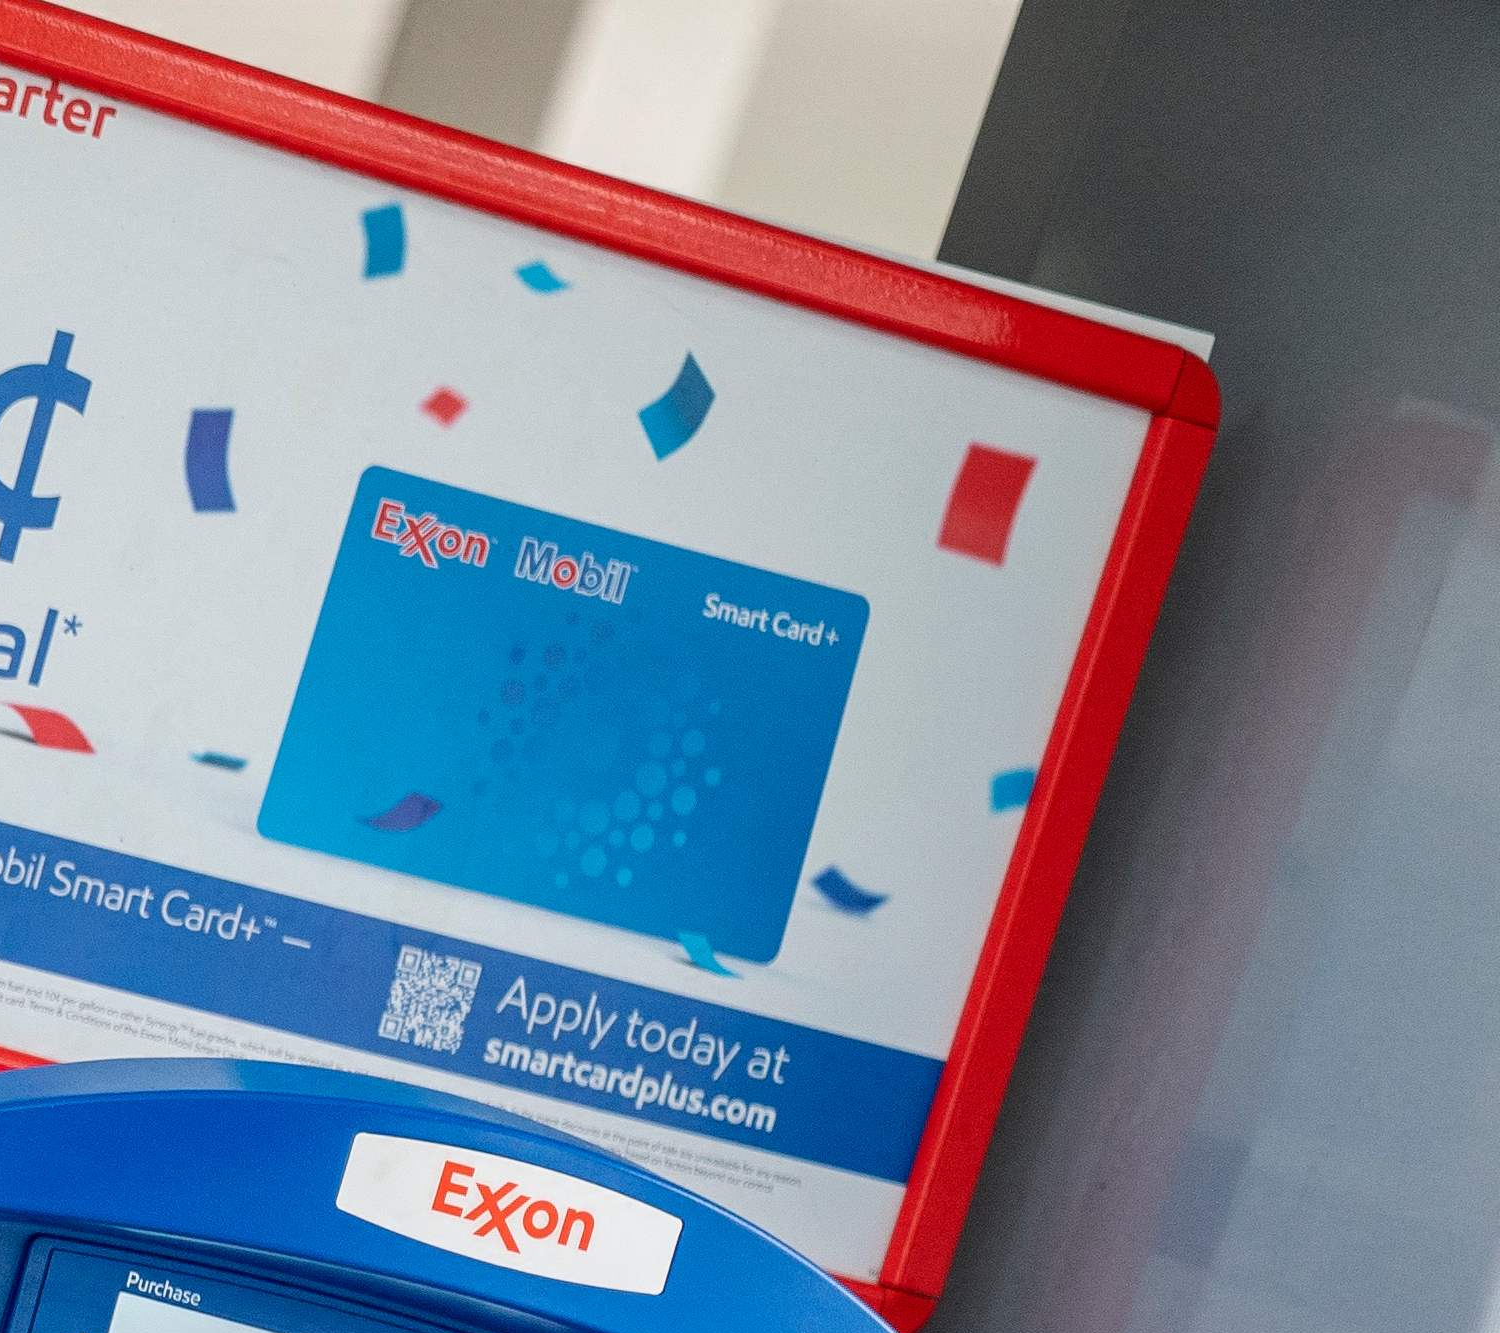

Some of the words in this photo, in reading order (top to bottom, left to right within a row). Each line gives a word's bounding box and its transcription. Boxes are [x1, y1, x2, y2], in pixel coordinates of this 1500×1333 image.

[371, 499, 497, 568] Exxon
[514, 536, 637, 604] Mobil
[49, 860, 154, 918] Smart
[496, 978, 617, 1049] Apply
[626, 1008, 740, 1080] today
[747, 1047, 789, 1083] at
[484, 1038, 775, 1135] smartcardplus.com
[432, 1161, 594, 1252] Exxon
[126, 1271, 200, 1306] Purchase
